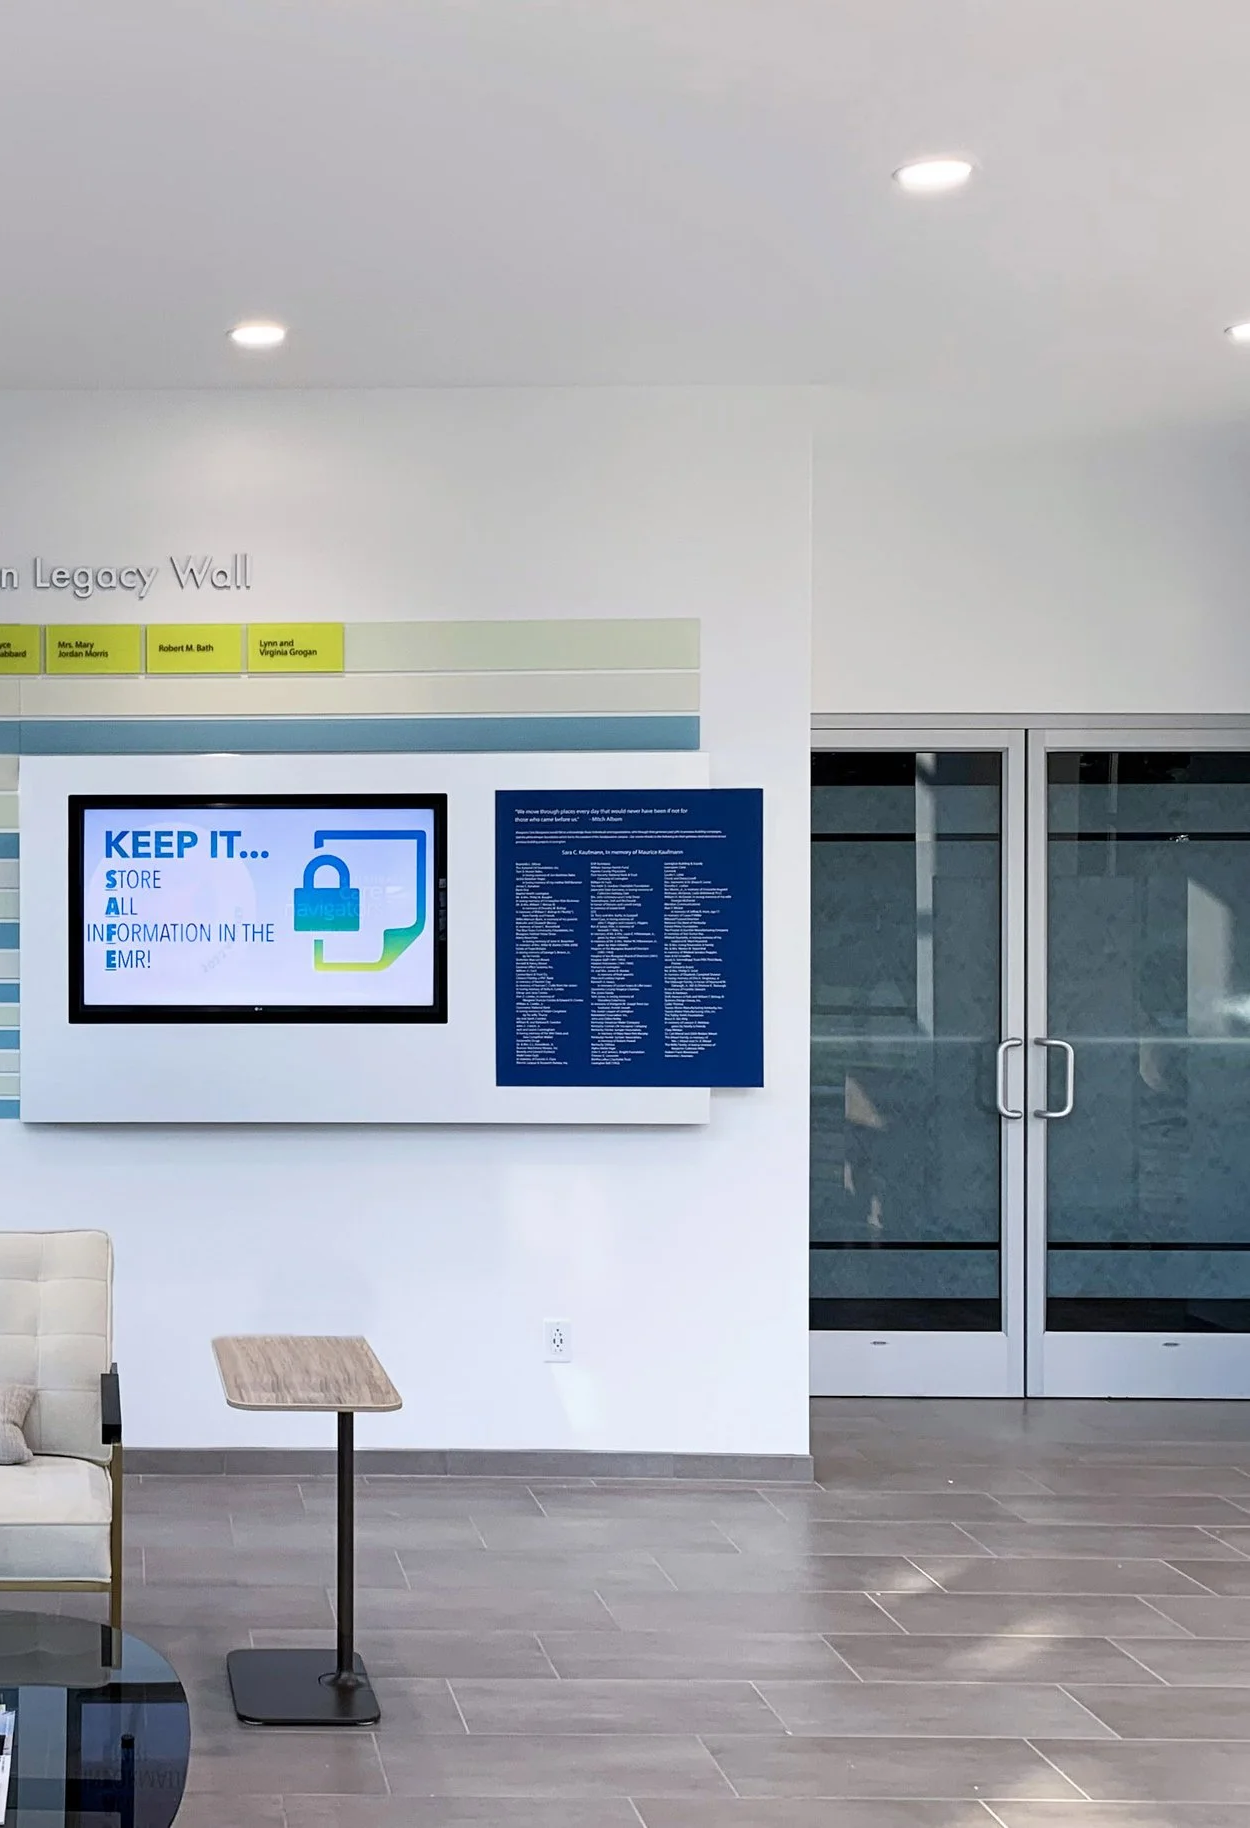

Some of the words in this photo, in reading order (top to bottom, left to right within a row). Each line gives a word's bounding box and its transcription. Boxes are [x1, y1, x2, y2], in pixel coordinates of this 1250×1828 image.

[34, 556, 158, 599] Legacy
[170, 553, 252, 590] Wall
[75, 641, 94, 650] Mary
[158, 644, 184, 652] Robert
[185, 644, 195, 652] M.
[196, 644, 214, 652] Bath
[259, 640, 278, 649] Lynn
[58, 650, 83, 658] Jordan
[84, 650, 109, 658] Morris
[259, 649, 288, 657] Virginia
[289, 649, 317, 657] Grogan
[540, 808, 560, 816] through
[591, 808, 599, 816] day
[105, 830, 198, 858] KEEP
[210, 830, 269, 858] IT...
[105, 870, 161, 889] STORE
[105, 897, 138, 915] ALL
[87, 923, 211, 943] INFORMATION
[219, 923, 235, 942] IN
[242, 923, 275, 942] THE
[105, 950, 150, 968] EMR!
